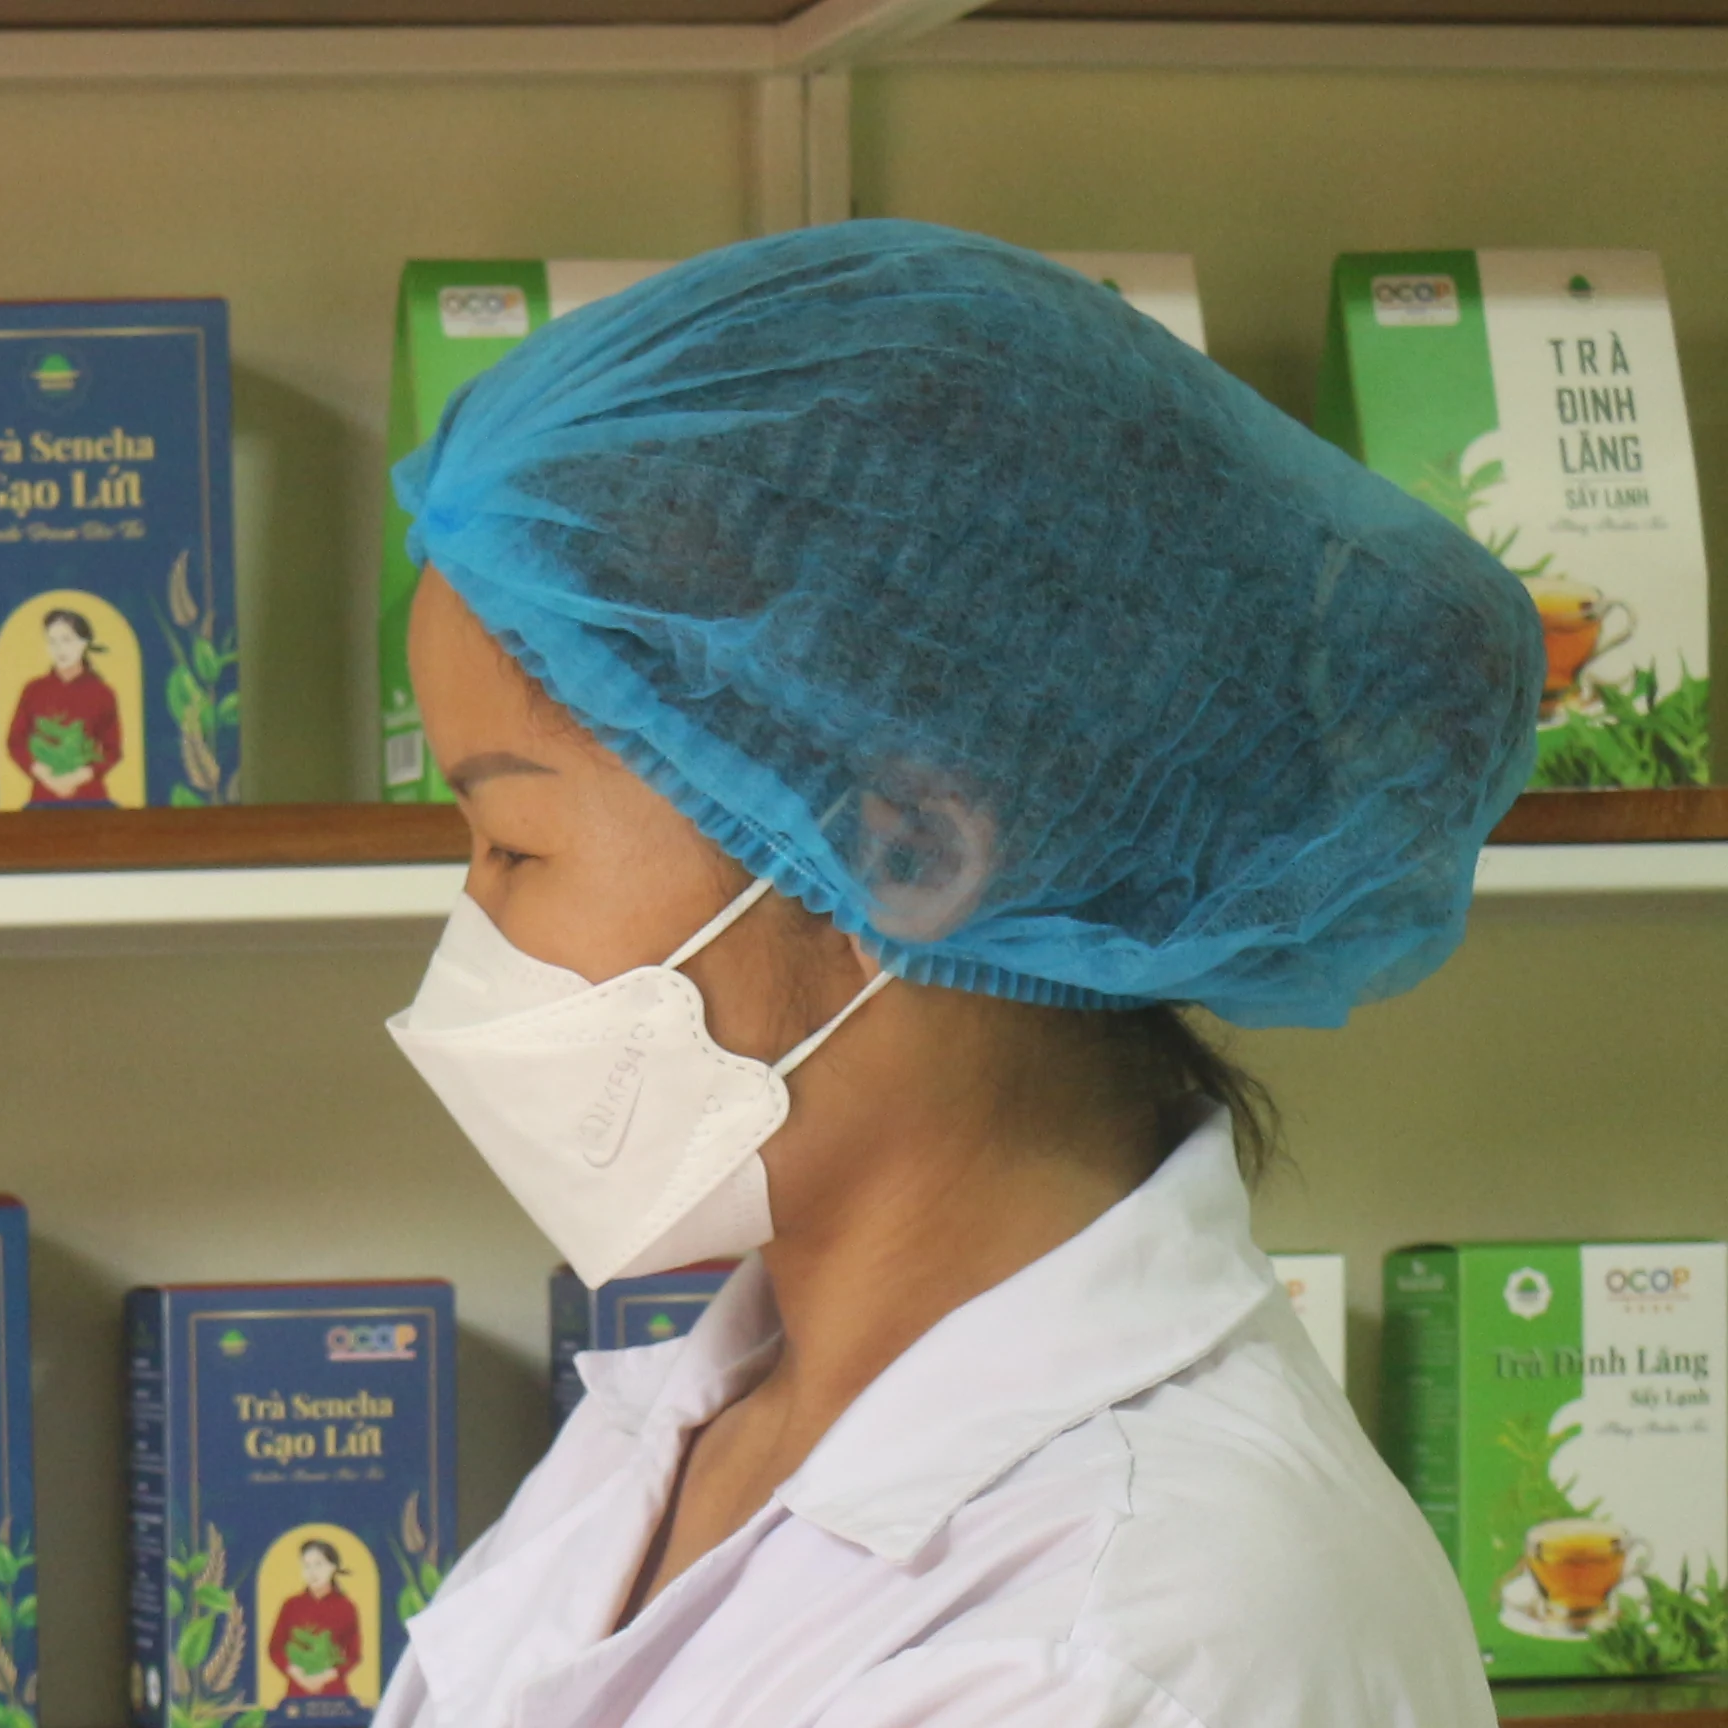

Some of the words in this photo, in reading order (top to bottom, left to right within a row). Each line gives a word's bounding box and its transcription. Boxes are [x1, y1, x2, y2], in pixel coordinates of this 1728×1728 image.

[1548, 331, 1632, 377] TRÀ
[1556, 387, 1638, 425] ĐINH
[29, 427, 156, 463] Sencha
[1558, 429, 1644, 475] LĂNG
[1605, 1266, 1691, 1294] OCOP
[234, 1390, 286, 1421] Trà
[292, 1389, 394, 1420] Sencha
[245, 1425, 316, 1467] Gạo
